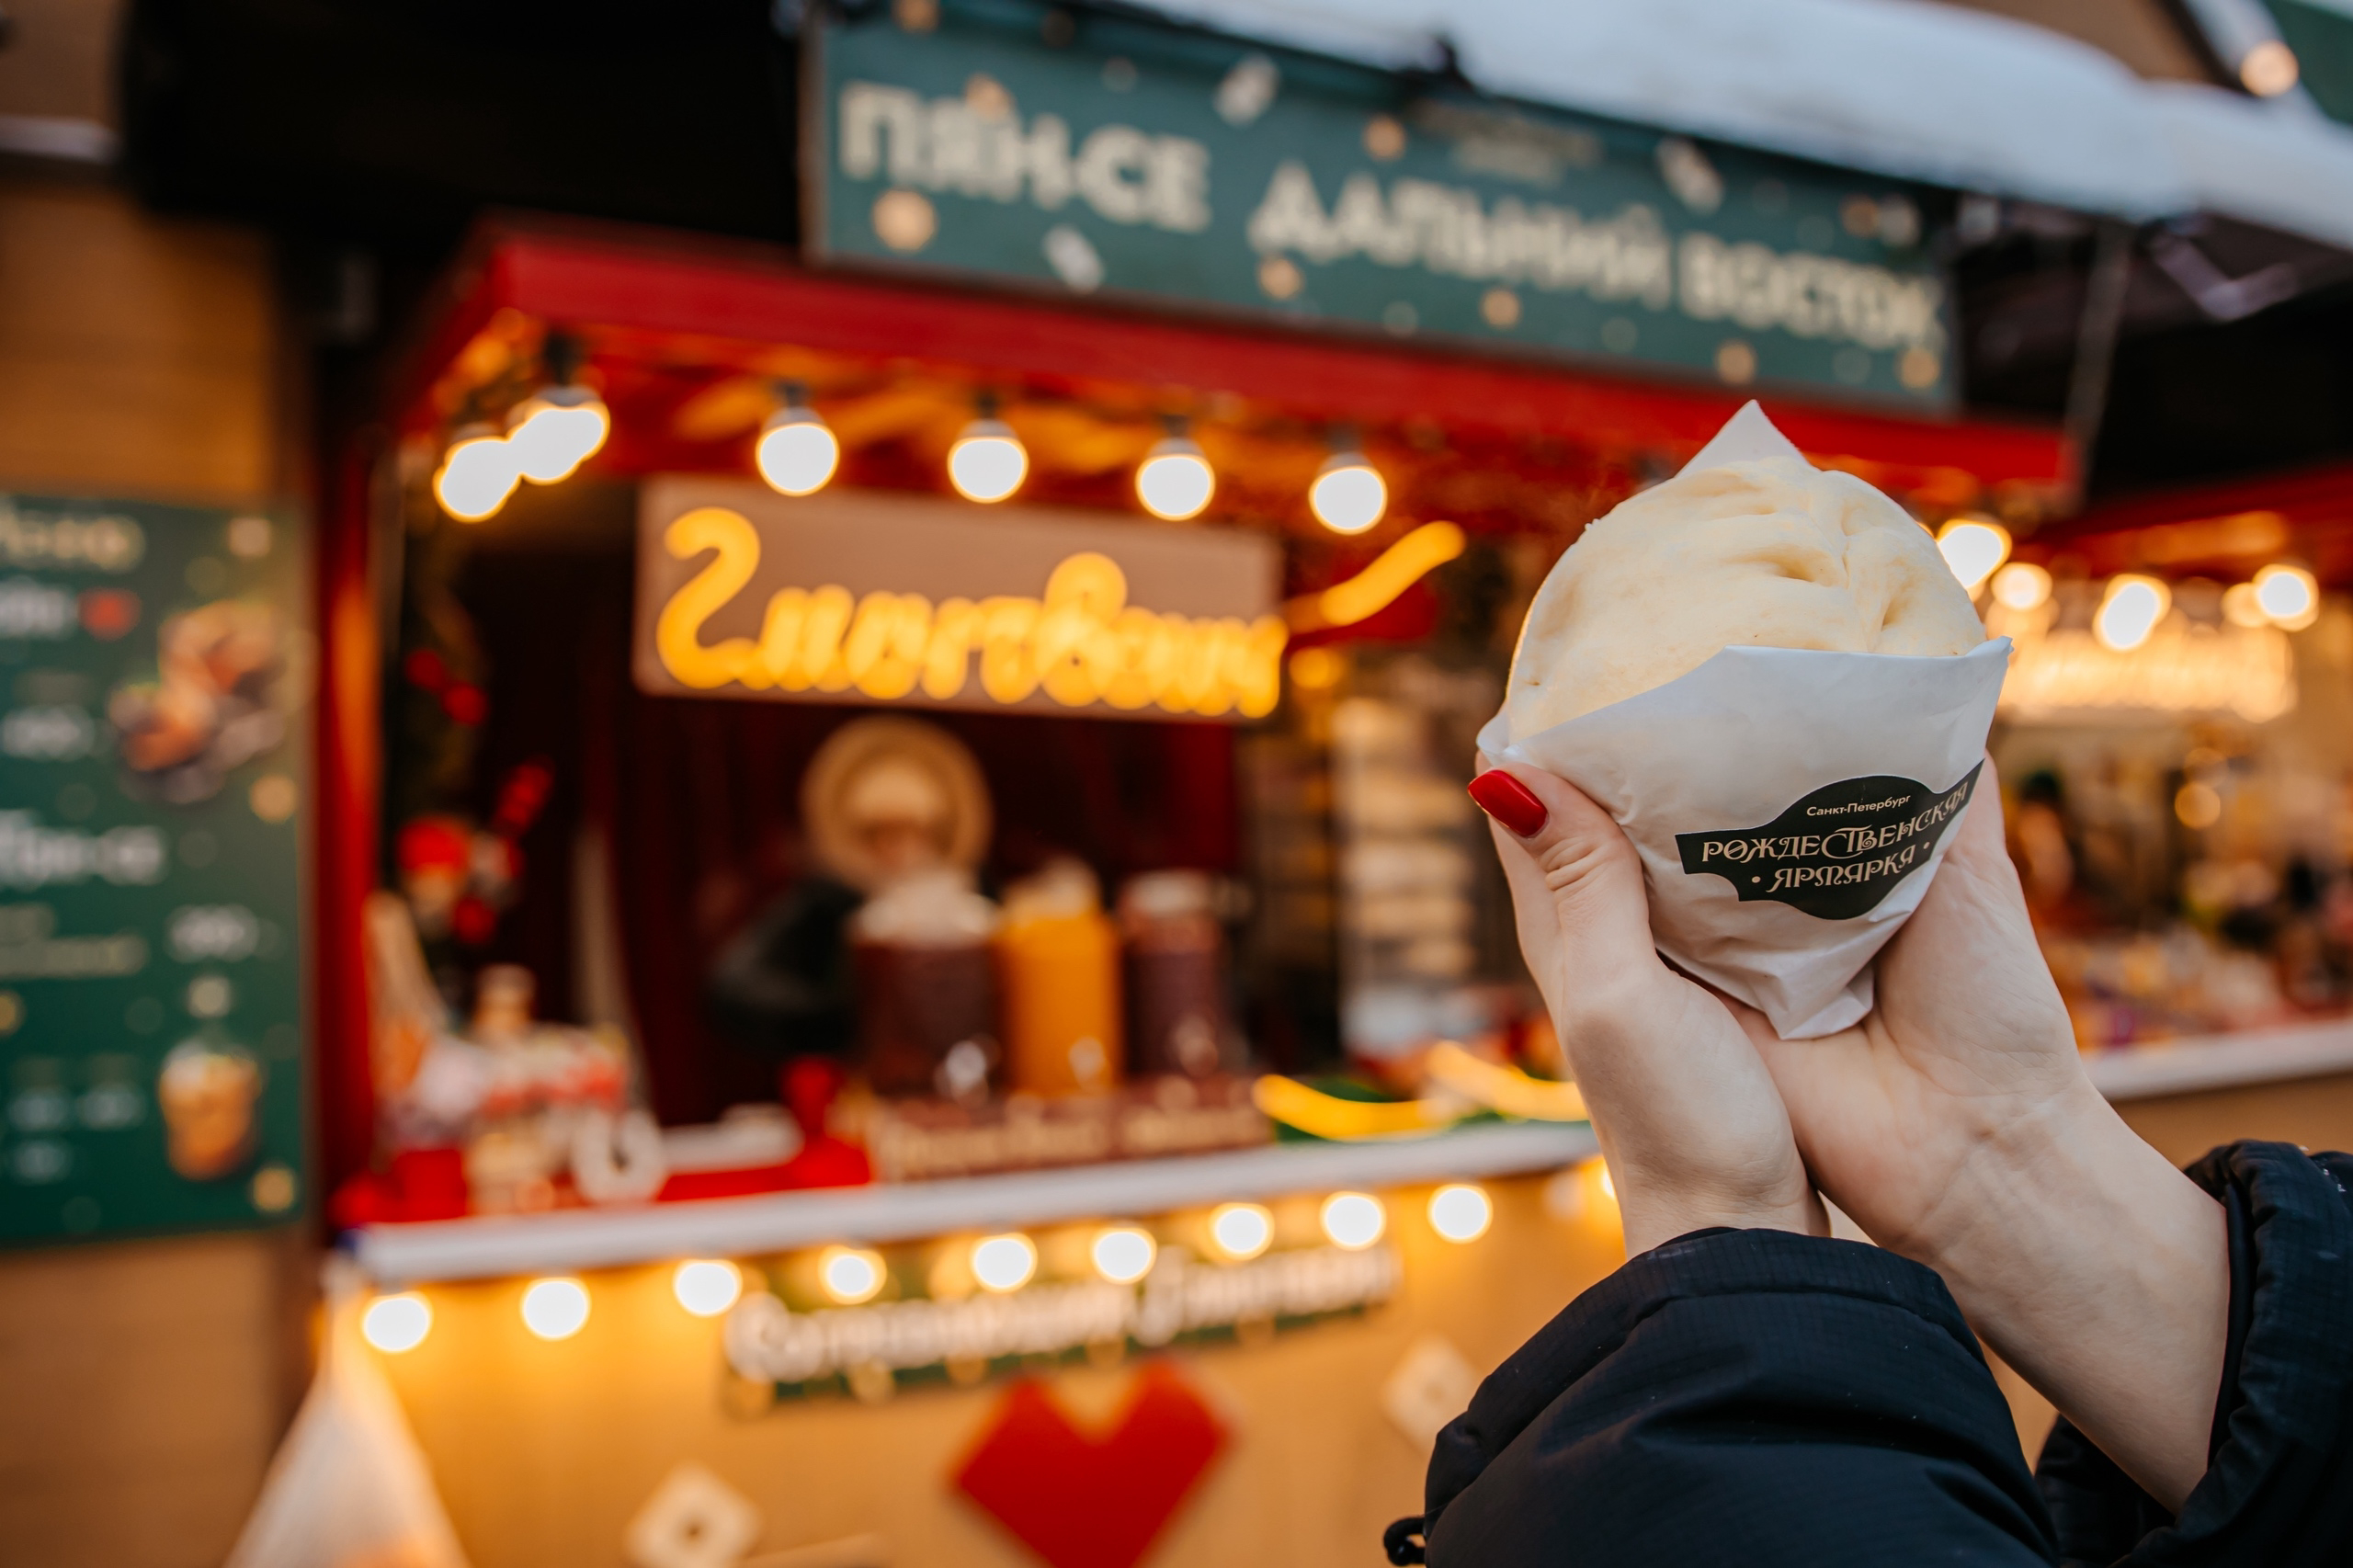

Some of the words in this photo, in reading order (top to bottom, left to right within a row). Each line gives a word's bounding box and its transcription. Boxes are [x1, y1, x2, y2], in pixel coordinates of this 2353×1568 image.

[1702, 782, 1969, 863] РОЖДЕСТВЕНСКАЯ
[1806, 795, 1912, 816] Санкт-Петербург
[1765, 844, 1916, 893] ЯРМАРКА
